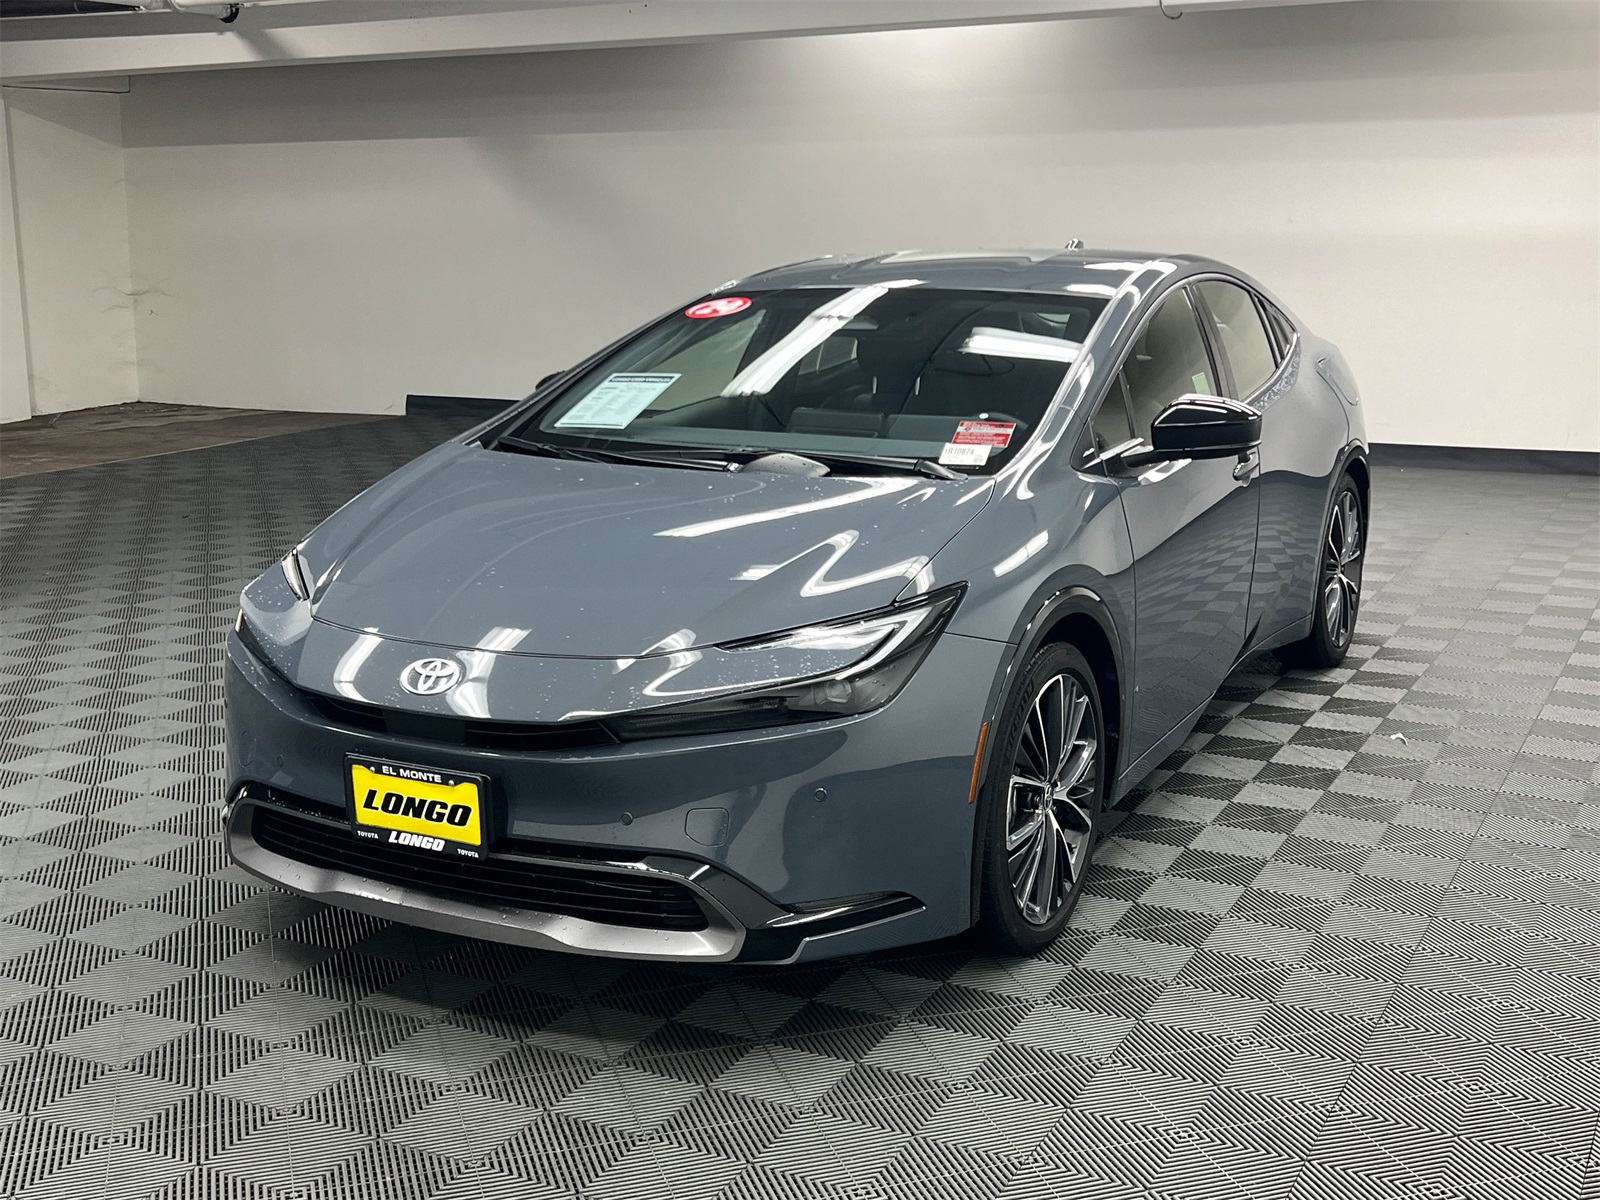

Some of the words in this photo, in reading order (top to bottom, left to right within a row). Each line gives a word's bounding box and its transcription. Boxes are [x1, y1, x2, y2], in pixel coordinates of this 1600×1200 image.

[381, 765, 397, 776] EL
[399, 768, 442, 783] MONTE
[362, 788, 472, 827] LONGO
[357, 830, 379, 840] TOYOTA
[388, 830, 446, 852] LONGO
[457, 848, 479, 859] TOYOTA
